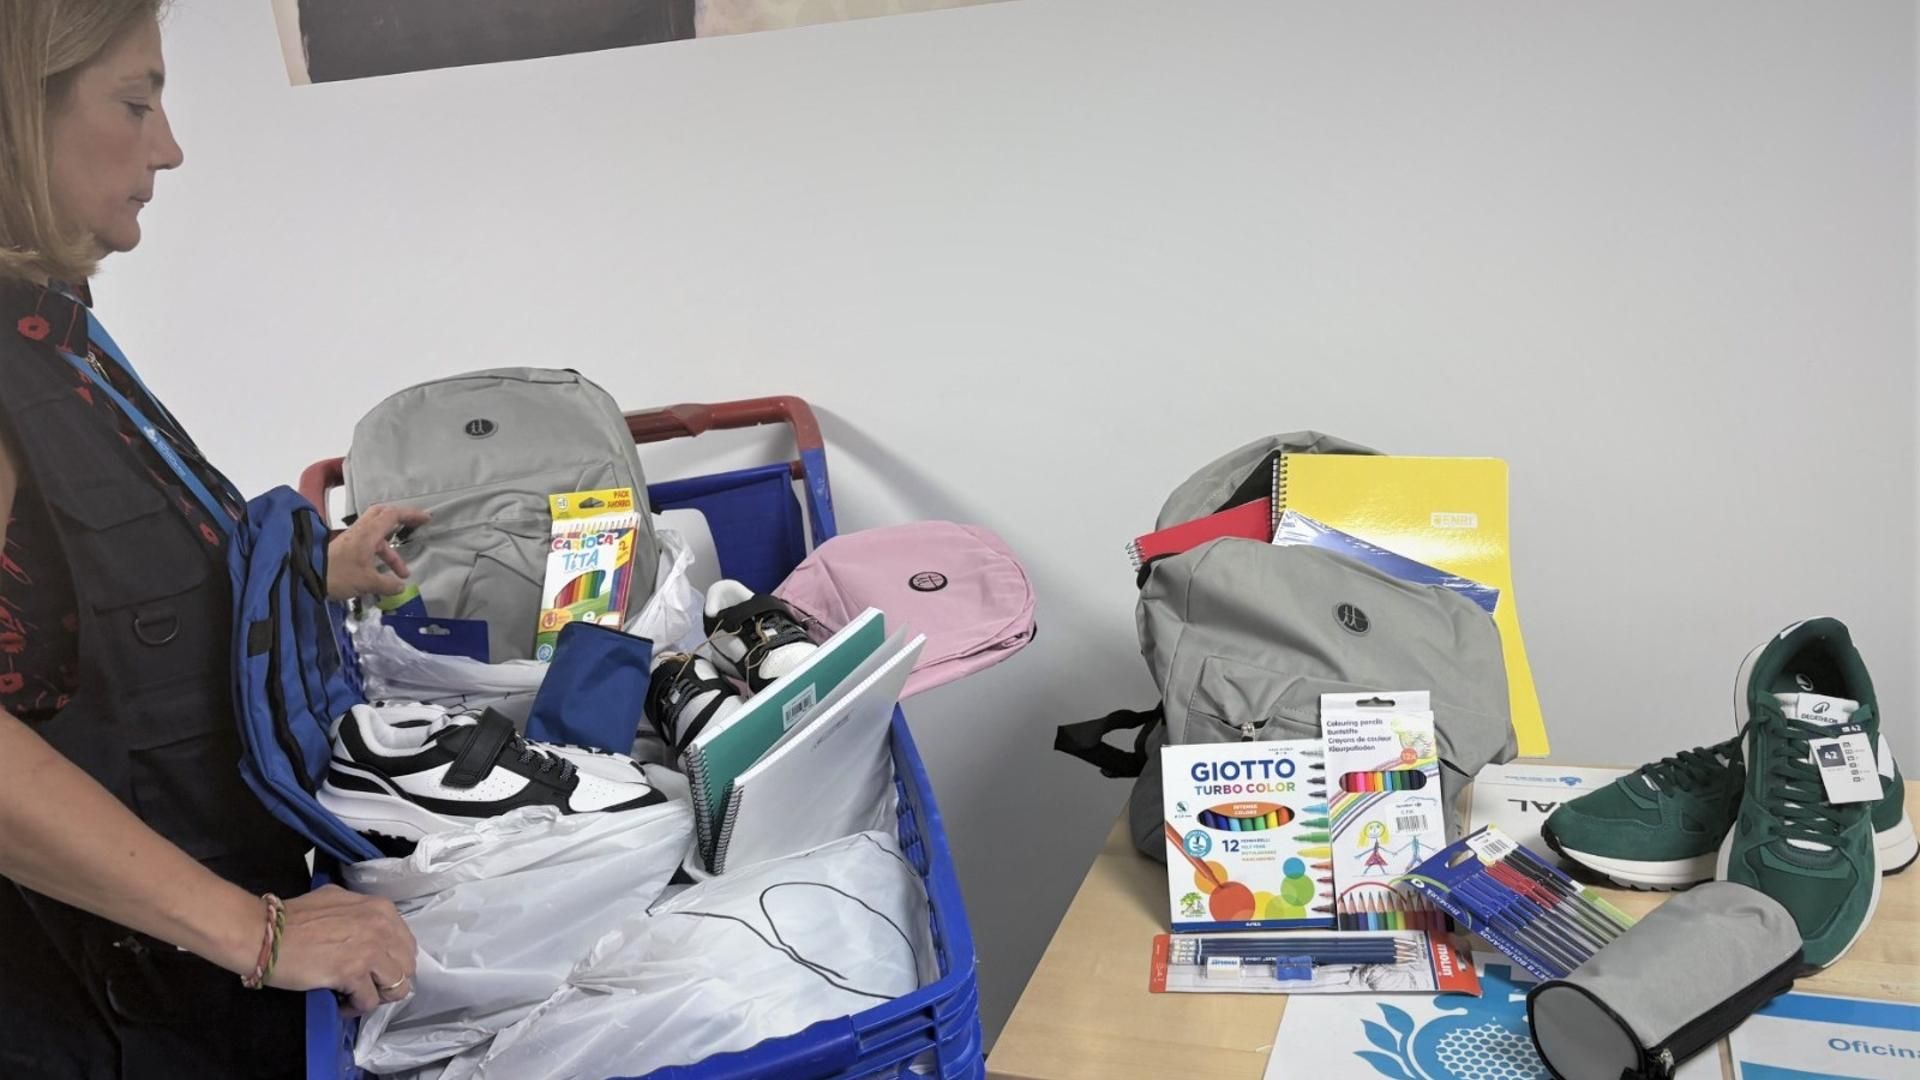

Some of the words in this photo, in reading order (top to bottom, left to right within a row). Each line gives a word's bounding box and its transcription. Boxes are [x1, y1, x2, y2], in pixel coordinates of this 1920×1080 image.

[553, 534, 614, 550] CARIOCA
[1327, 719, 1358, 727] Colouring
[1360, 718, 1383, 726] pencils
[1801, 713, 1838, 723] DECATHLON
[1824, 751, 1838, 759] 42
[1191, 758, 1296, 782] GIOTTO
[1194, 784, 1243, 796] TURBO
[1246, 782, 1296, 794] COLOR
[1222, 839, 1240, 852] 12
[1828, 1038, 1920, 1059] Oficin
